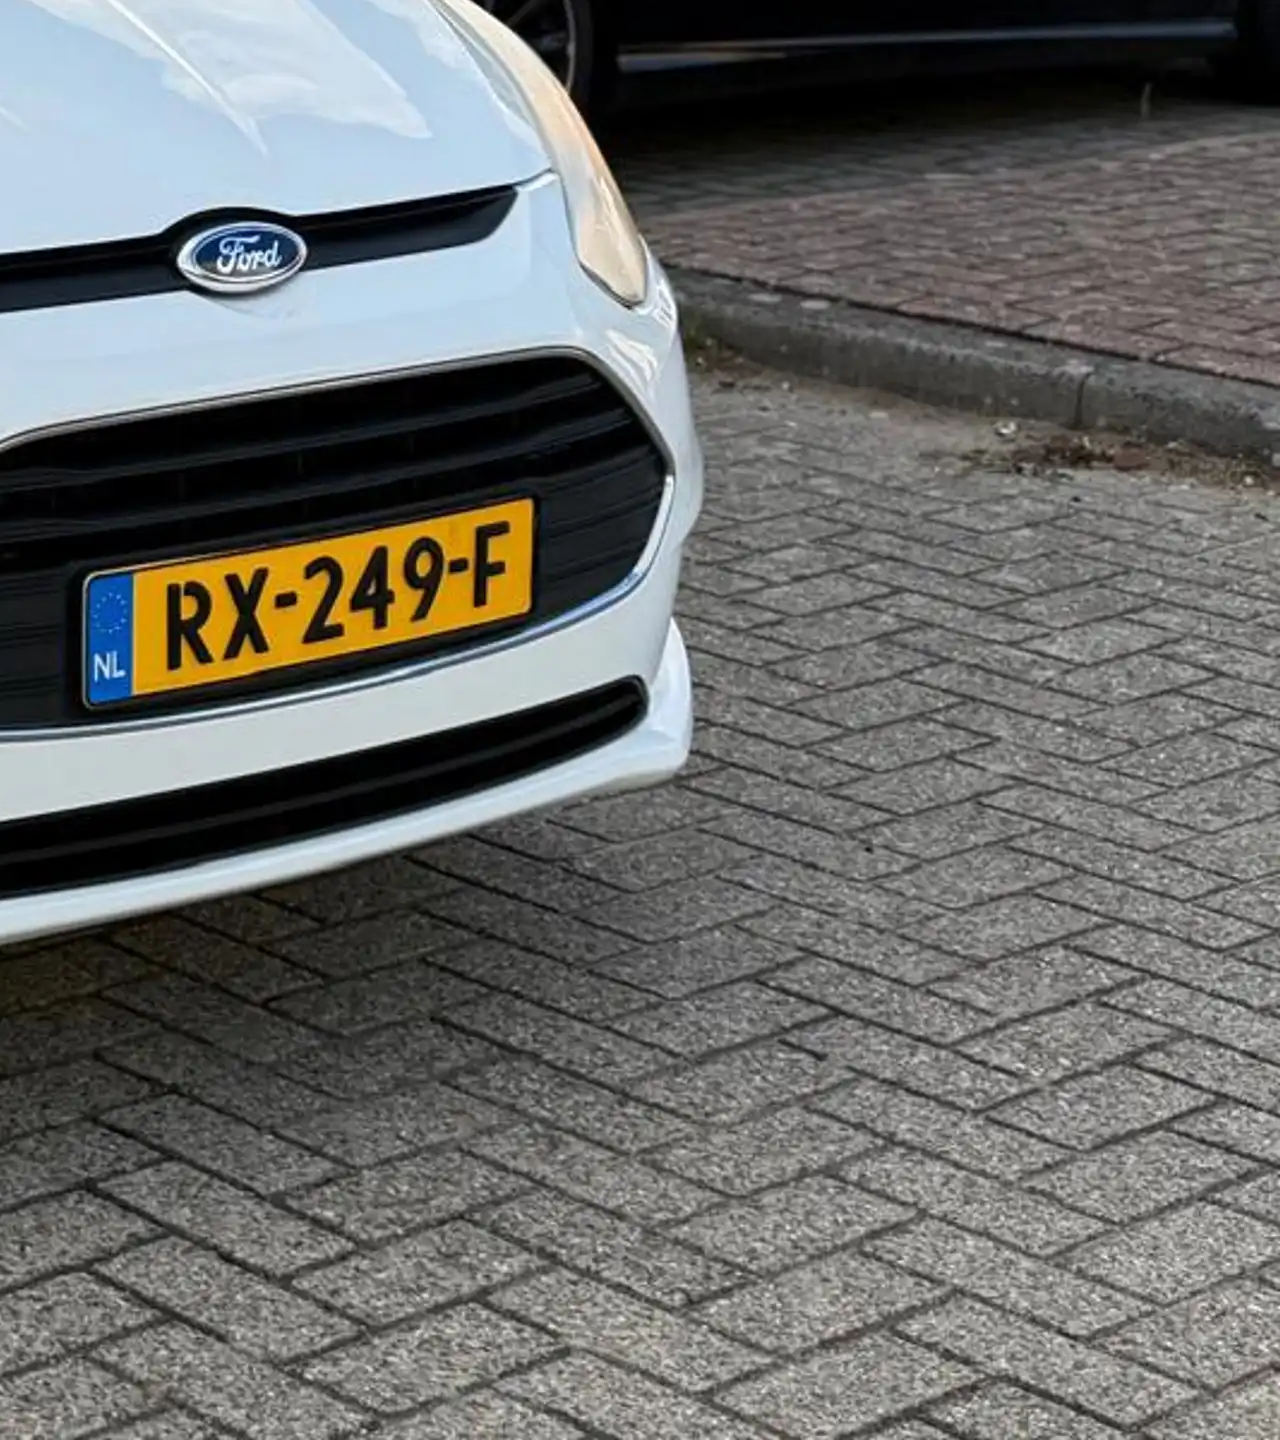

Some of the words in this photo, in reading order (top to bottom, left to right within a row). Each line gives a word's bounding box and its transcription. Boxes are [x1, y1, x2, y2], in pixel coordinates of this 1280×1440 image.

[216, 234, 283, 275] Ford
[93, 651, 127, 683] NL
[166, 520, 511, 672] RX-249-F
